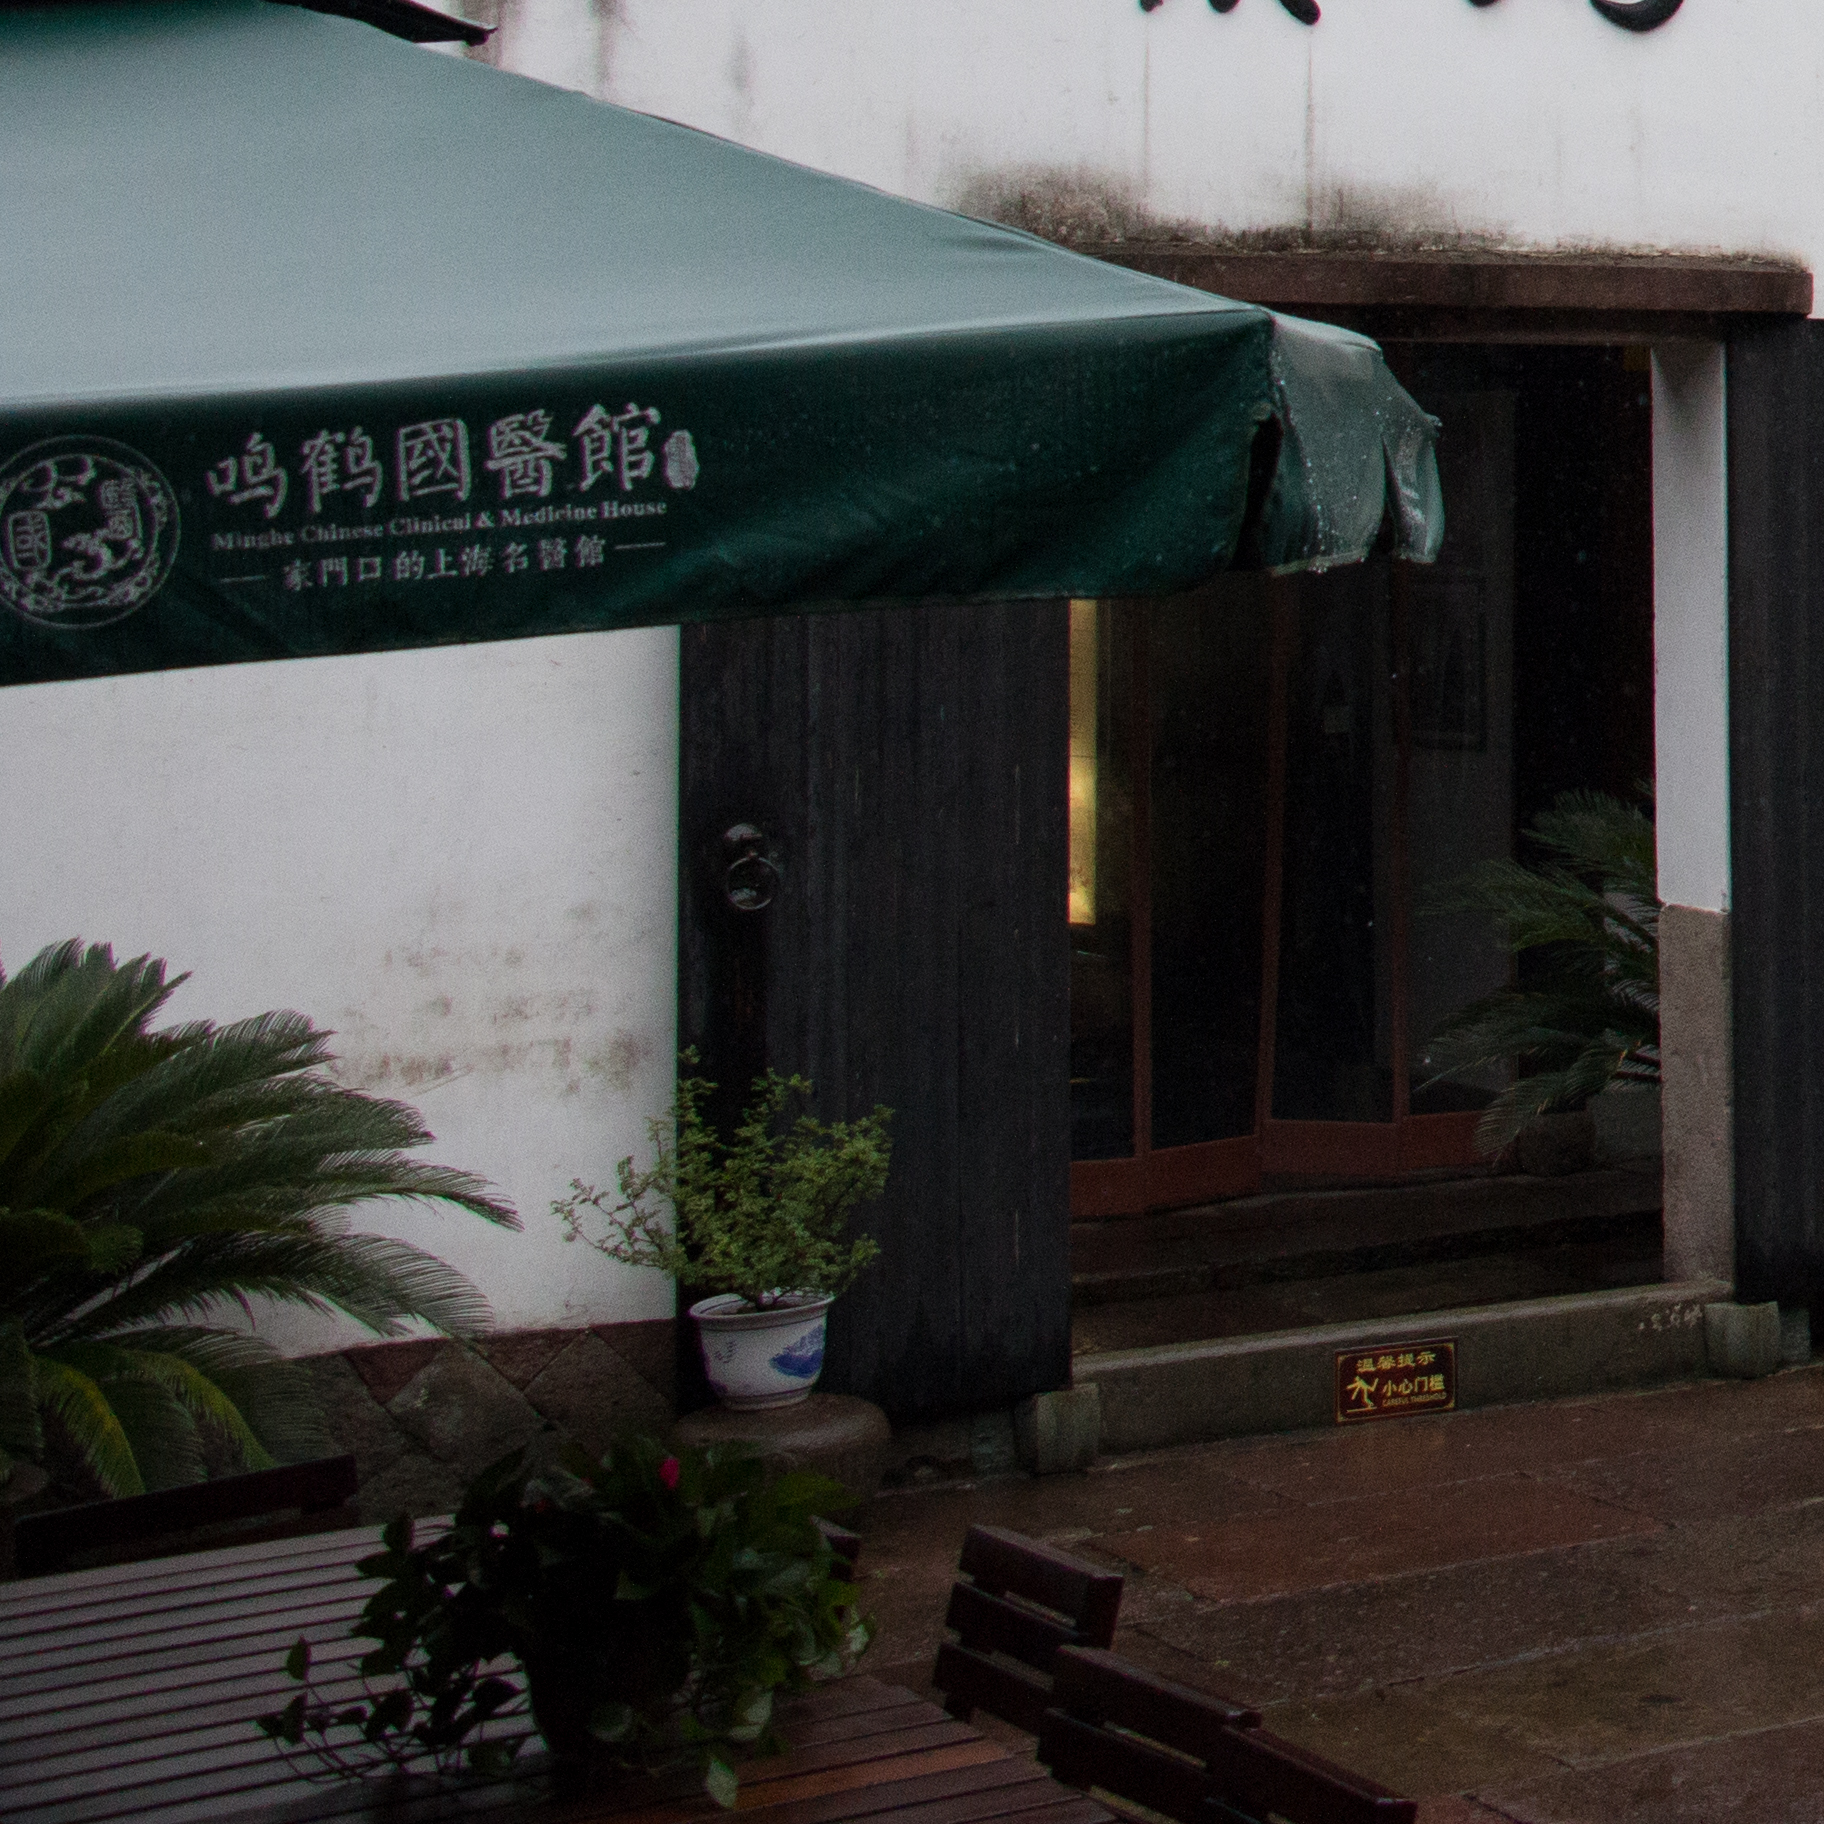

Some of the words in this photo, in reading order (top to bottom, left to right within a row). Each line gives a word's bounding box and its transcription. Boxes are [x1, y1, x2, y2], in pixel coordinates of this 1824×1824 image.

[205, 402, 663, 520] 鸣鹤國醫館
[211, 529, 295, 551] Minghe
[300, 523, 385, 544] Chinese
[385, 512, 472, 536] Clinical
[474, 511, 495, 530] &
[498, 503, 598, 528] Medicine
[599, 499, 668, 519] House
[282, 533, 607, 591] 家門口的上海名醫館
[1355, 1350, 1437, 1374] 温馨提示
